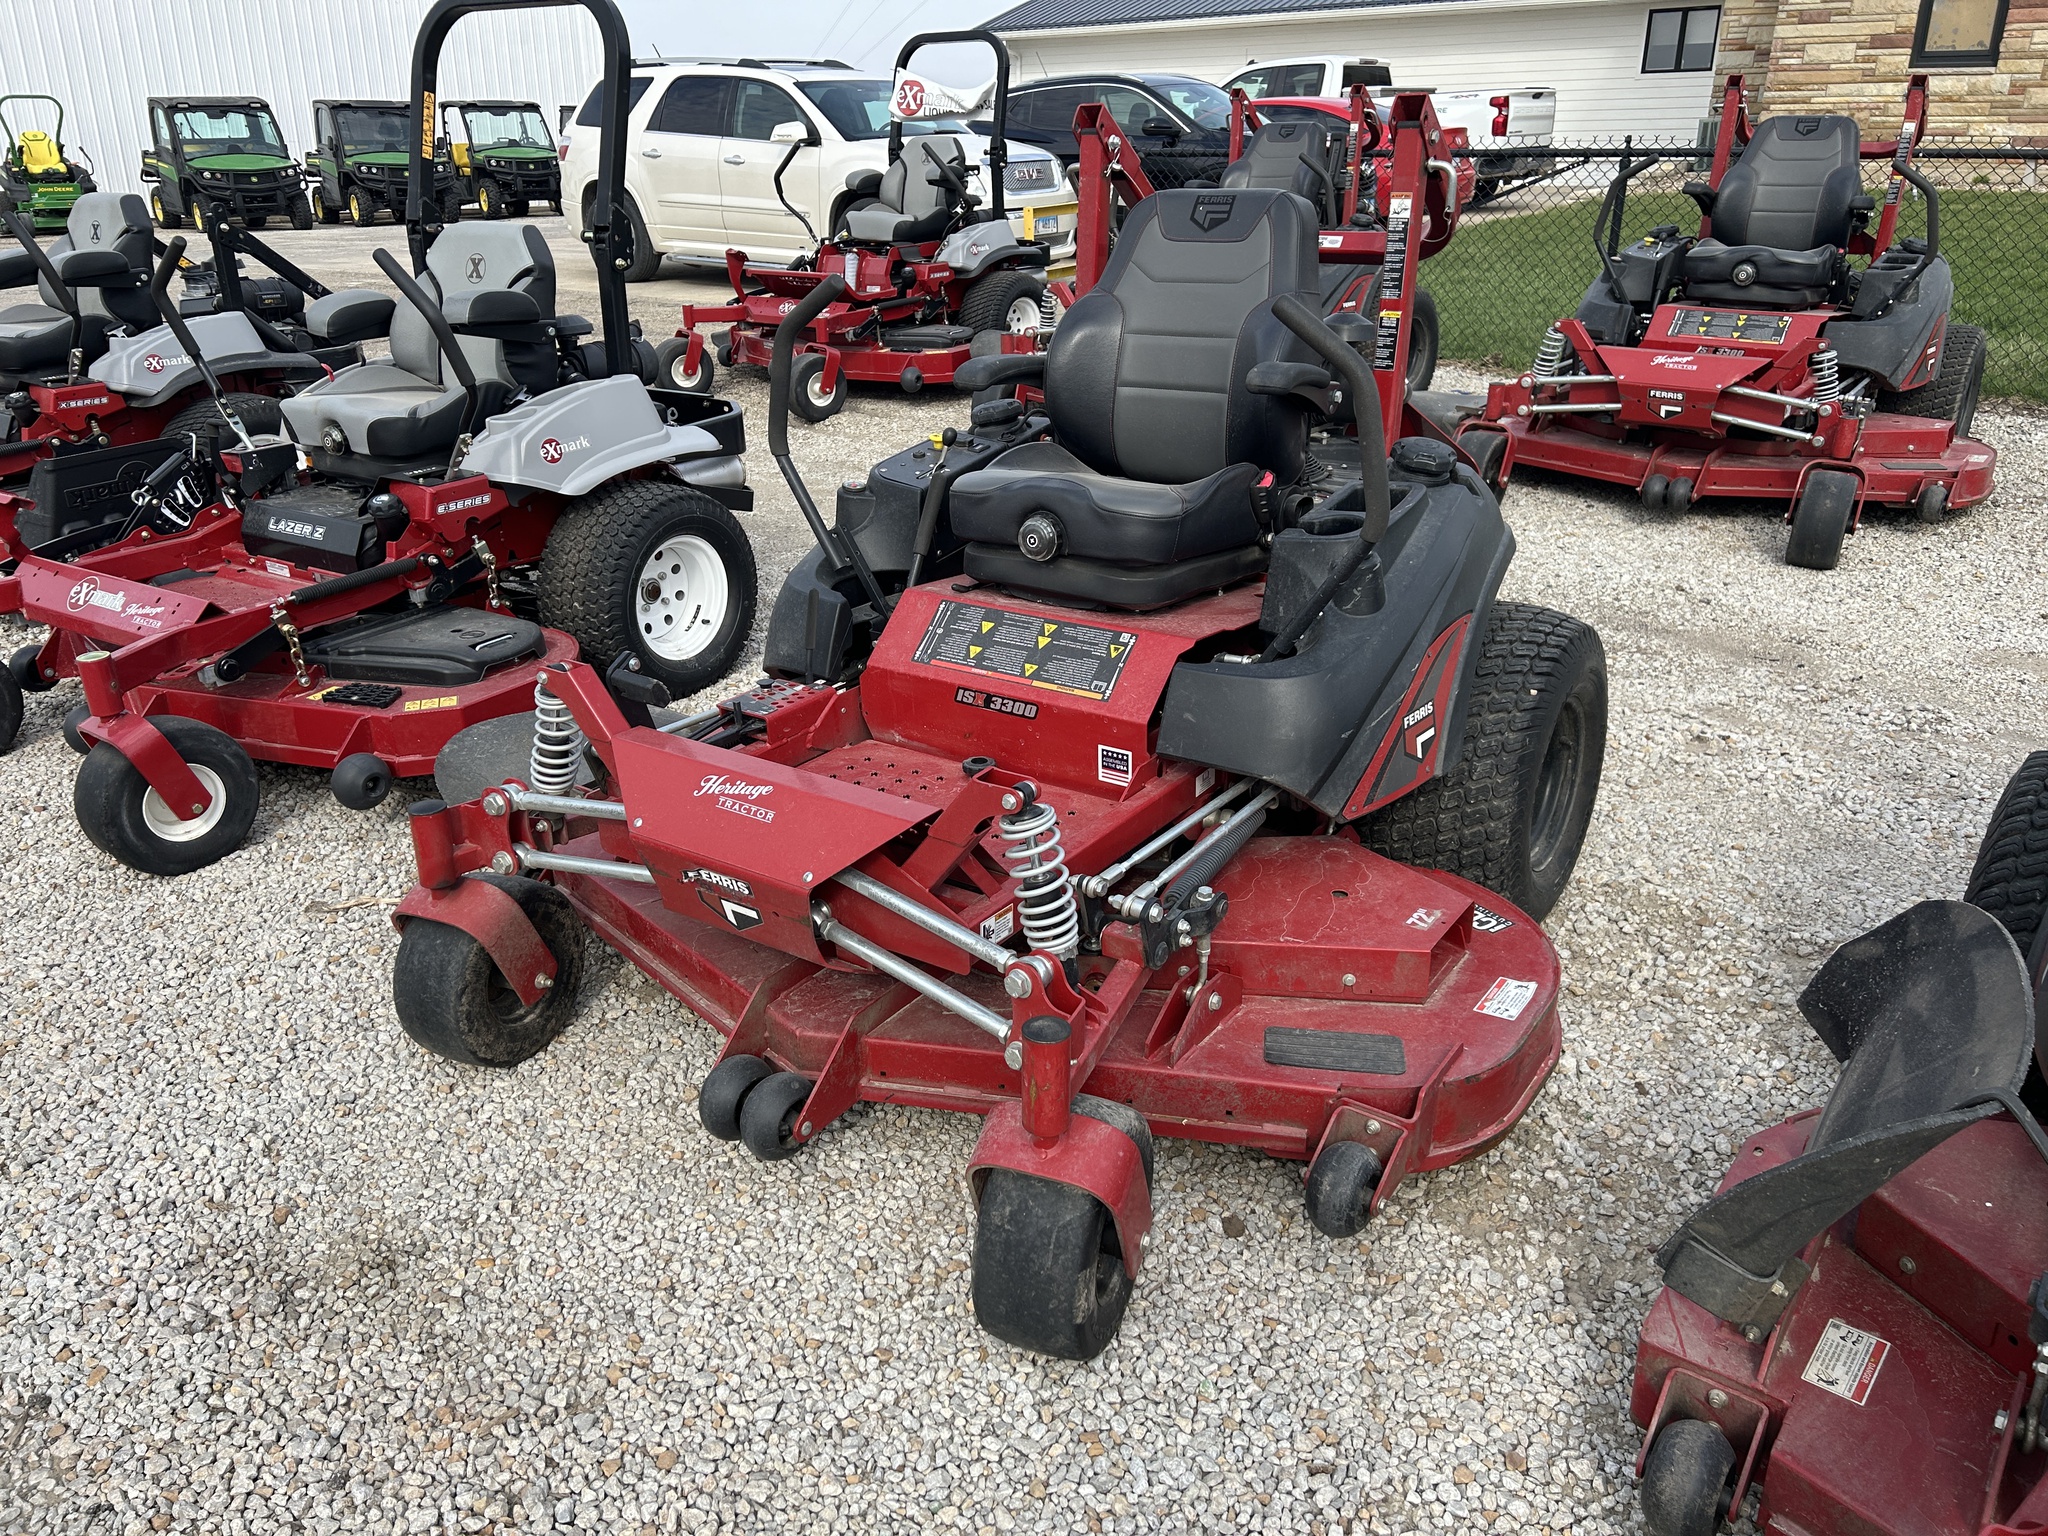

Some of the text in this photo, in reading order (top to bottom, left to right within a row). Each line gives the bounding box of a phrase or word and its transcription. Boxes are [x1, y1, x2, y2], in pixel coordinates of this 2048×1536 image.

[1199, 195, 1233, 203] FERRIS
[1650, 355, 1694, 366] Heritage
[1663, 363, 1698, 371] TRACTOR
[1649, 390, 1684, 400] FERRIS
[268, 516, 327, 541] LAZER Z
[120, 602, 166, 618] Heritage
[131, 615, 163, 629] TRACTOR
[956, 688, 1038, 719] ISX 3300
[1403, 701, 1434, 729] FERRIS
[693, 774, 774, 800] Heritage
[718, 797, 775, 822] TRACTOR
[1860, 1362, 1876, 1384] DANGER
